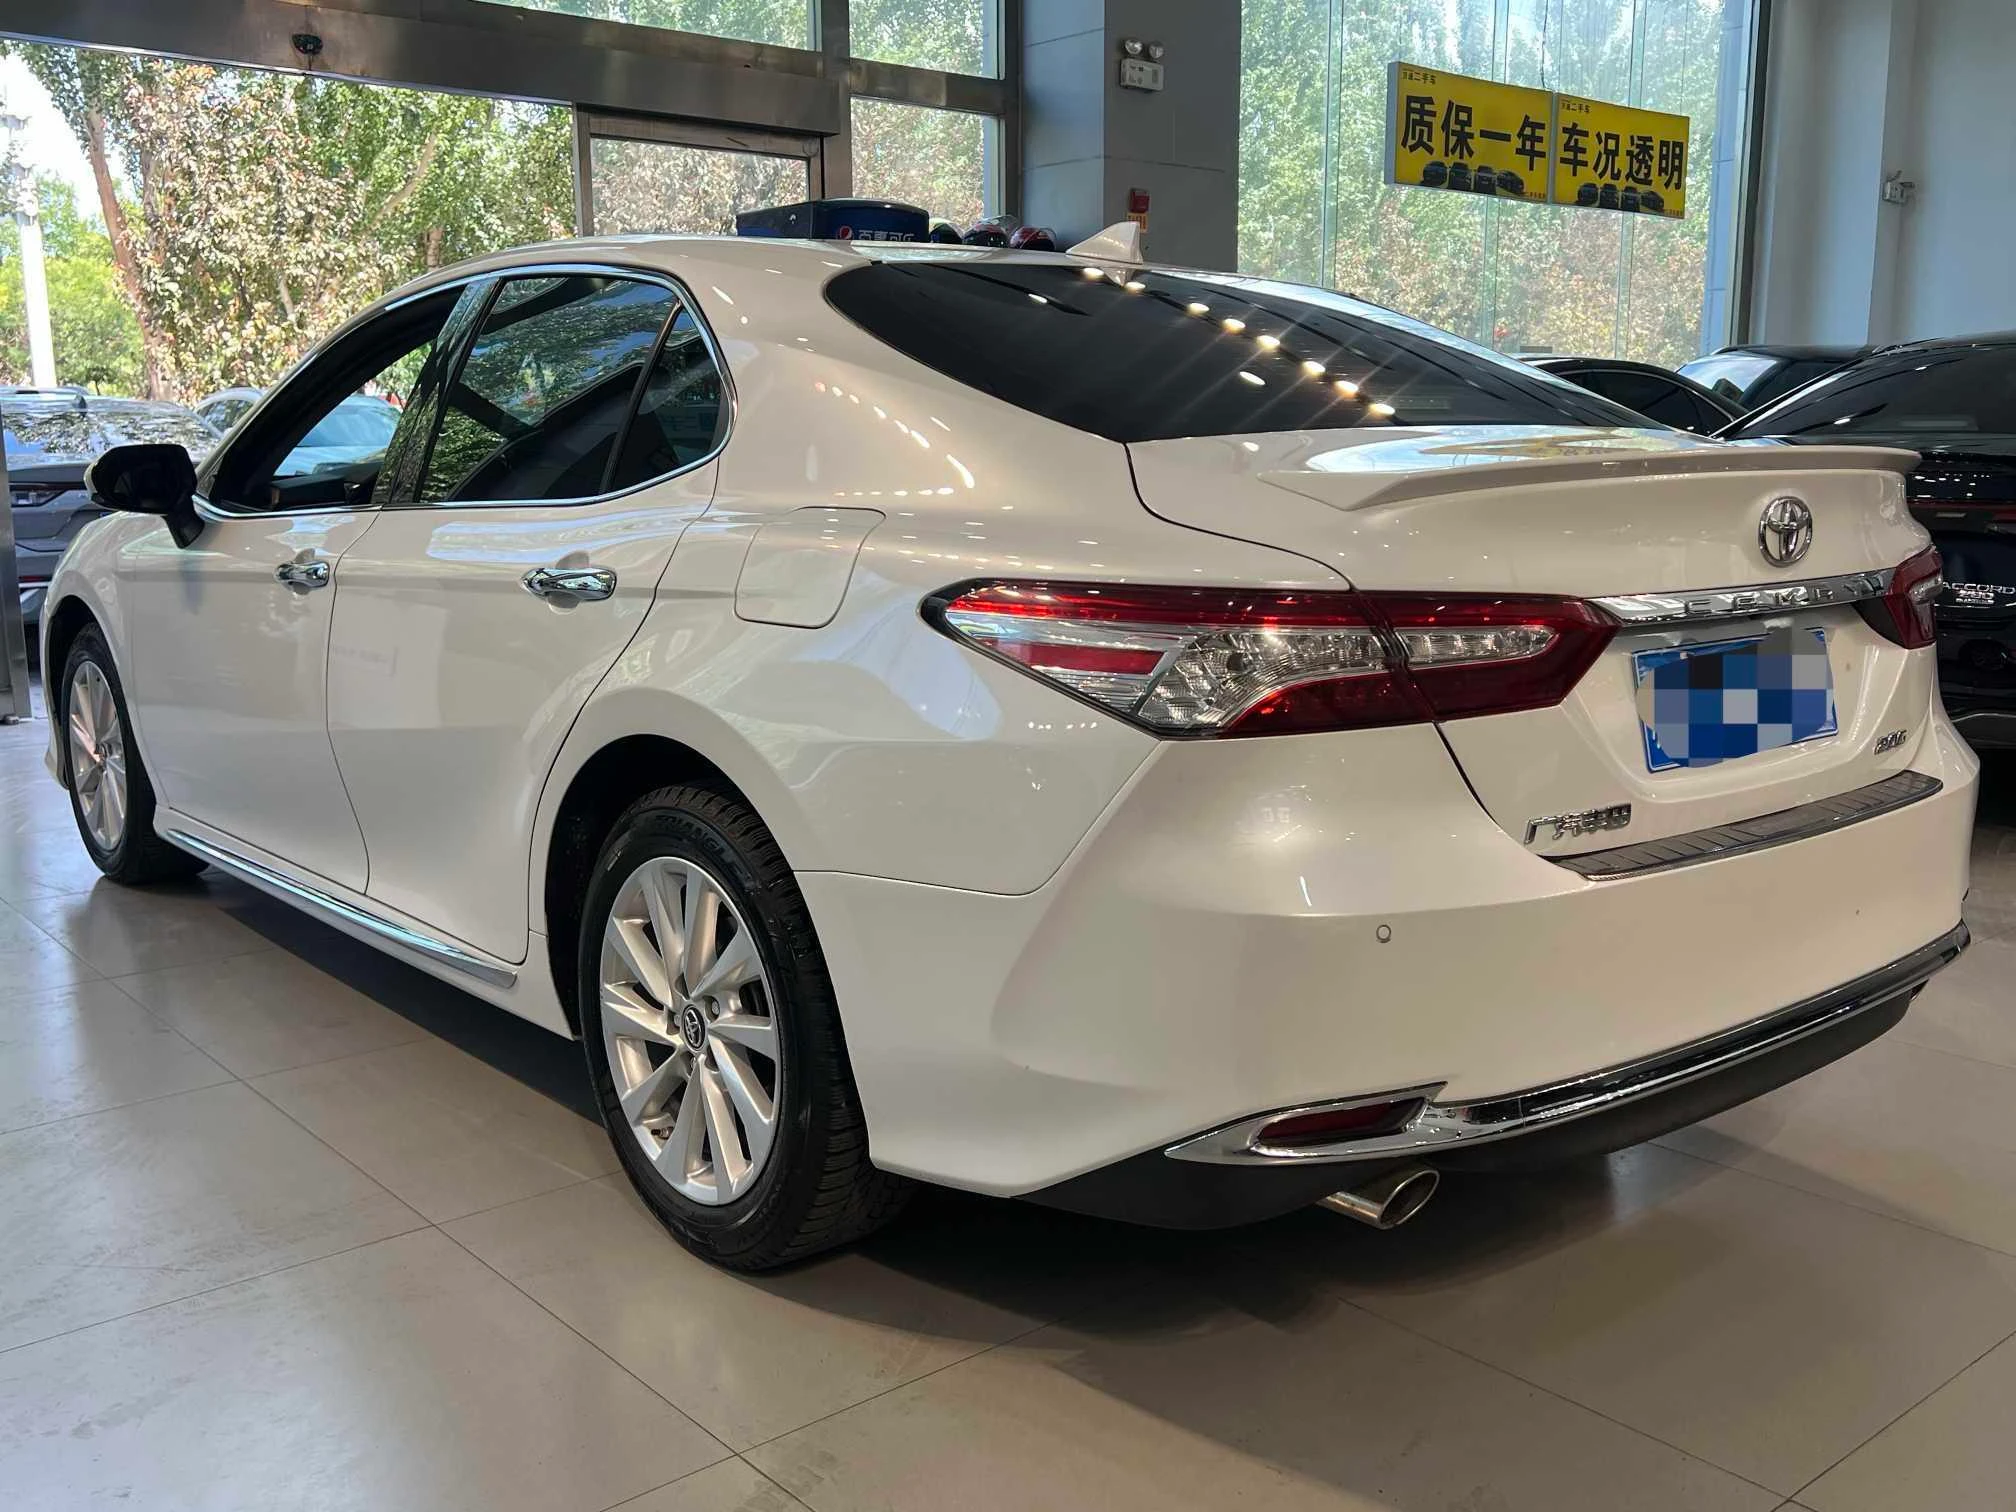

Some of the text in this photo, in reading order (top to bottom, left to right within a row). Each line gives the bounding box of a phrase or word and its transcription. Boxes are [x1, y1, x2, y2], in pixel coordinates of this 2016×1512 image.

[1401, 95, 1547, 172] 质保一年
[1559, 121, 1684, 191] 车况透明
[1943, 581, 2016, 595] ACCORD
